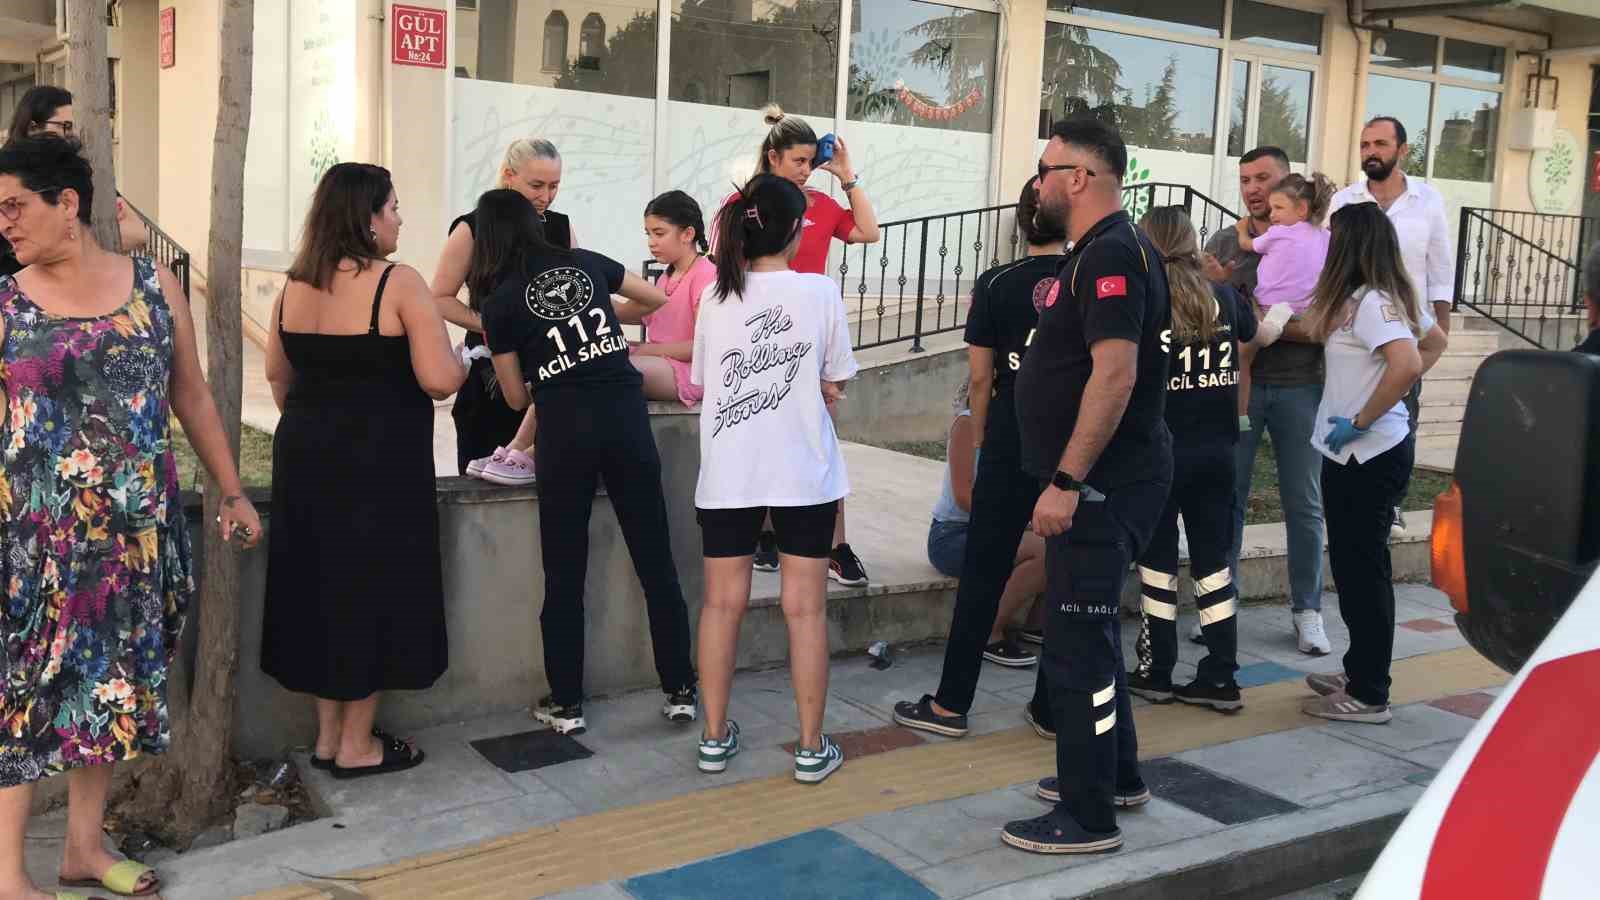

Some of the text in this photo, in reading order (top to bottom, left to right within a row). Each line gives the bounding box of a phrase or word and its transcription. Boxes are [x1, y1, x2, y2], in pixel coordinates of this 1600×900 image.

[399, 13, 440, 34] GÜL
[400, 33, 439, 52] APT
[546, 307, 612, 354] 112
[745, 304, 793, 344] The
[538, 354, 577, 381] ACİL
[720, 342, 812, 395] Rolling
[1178, 341, 1233, 373] 112
